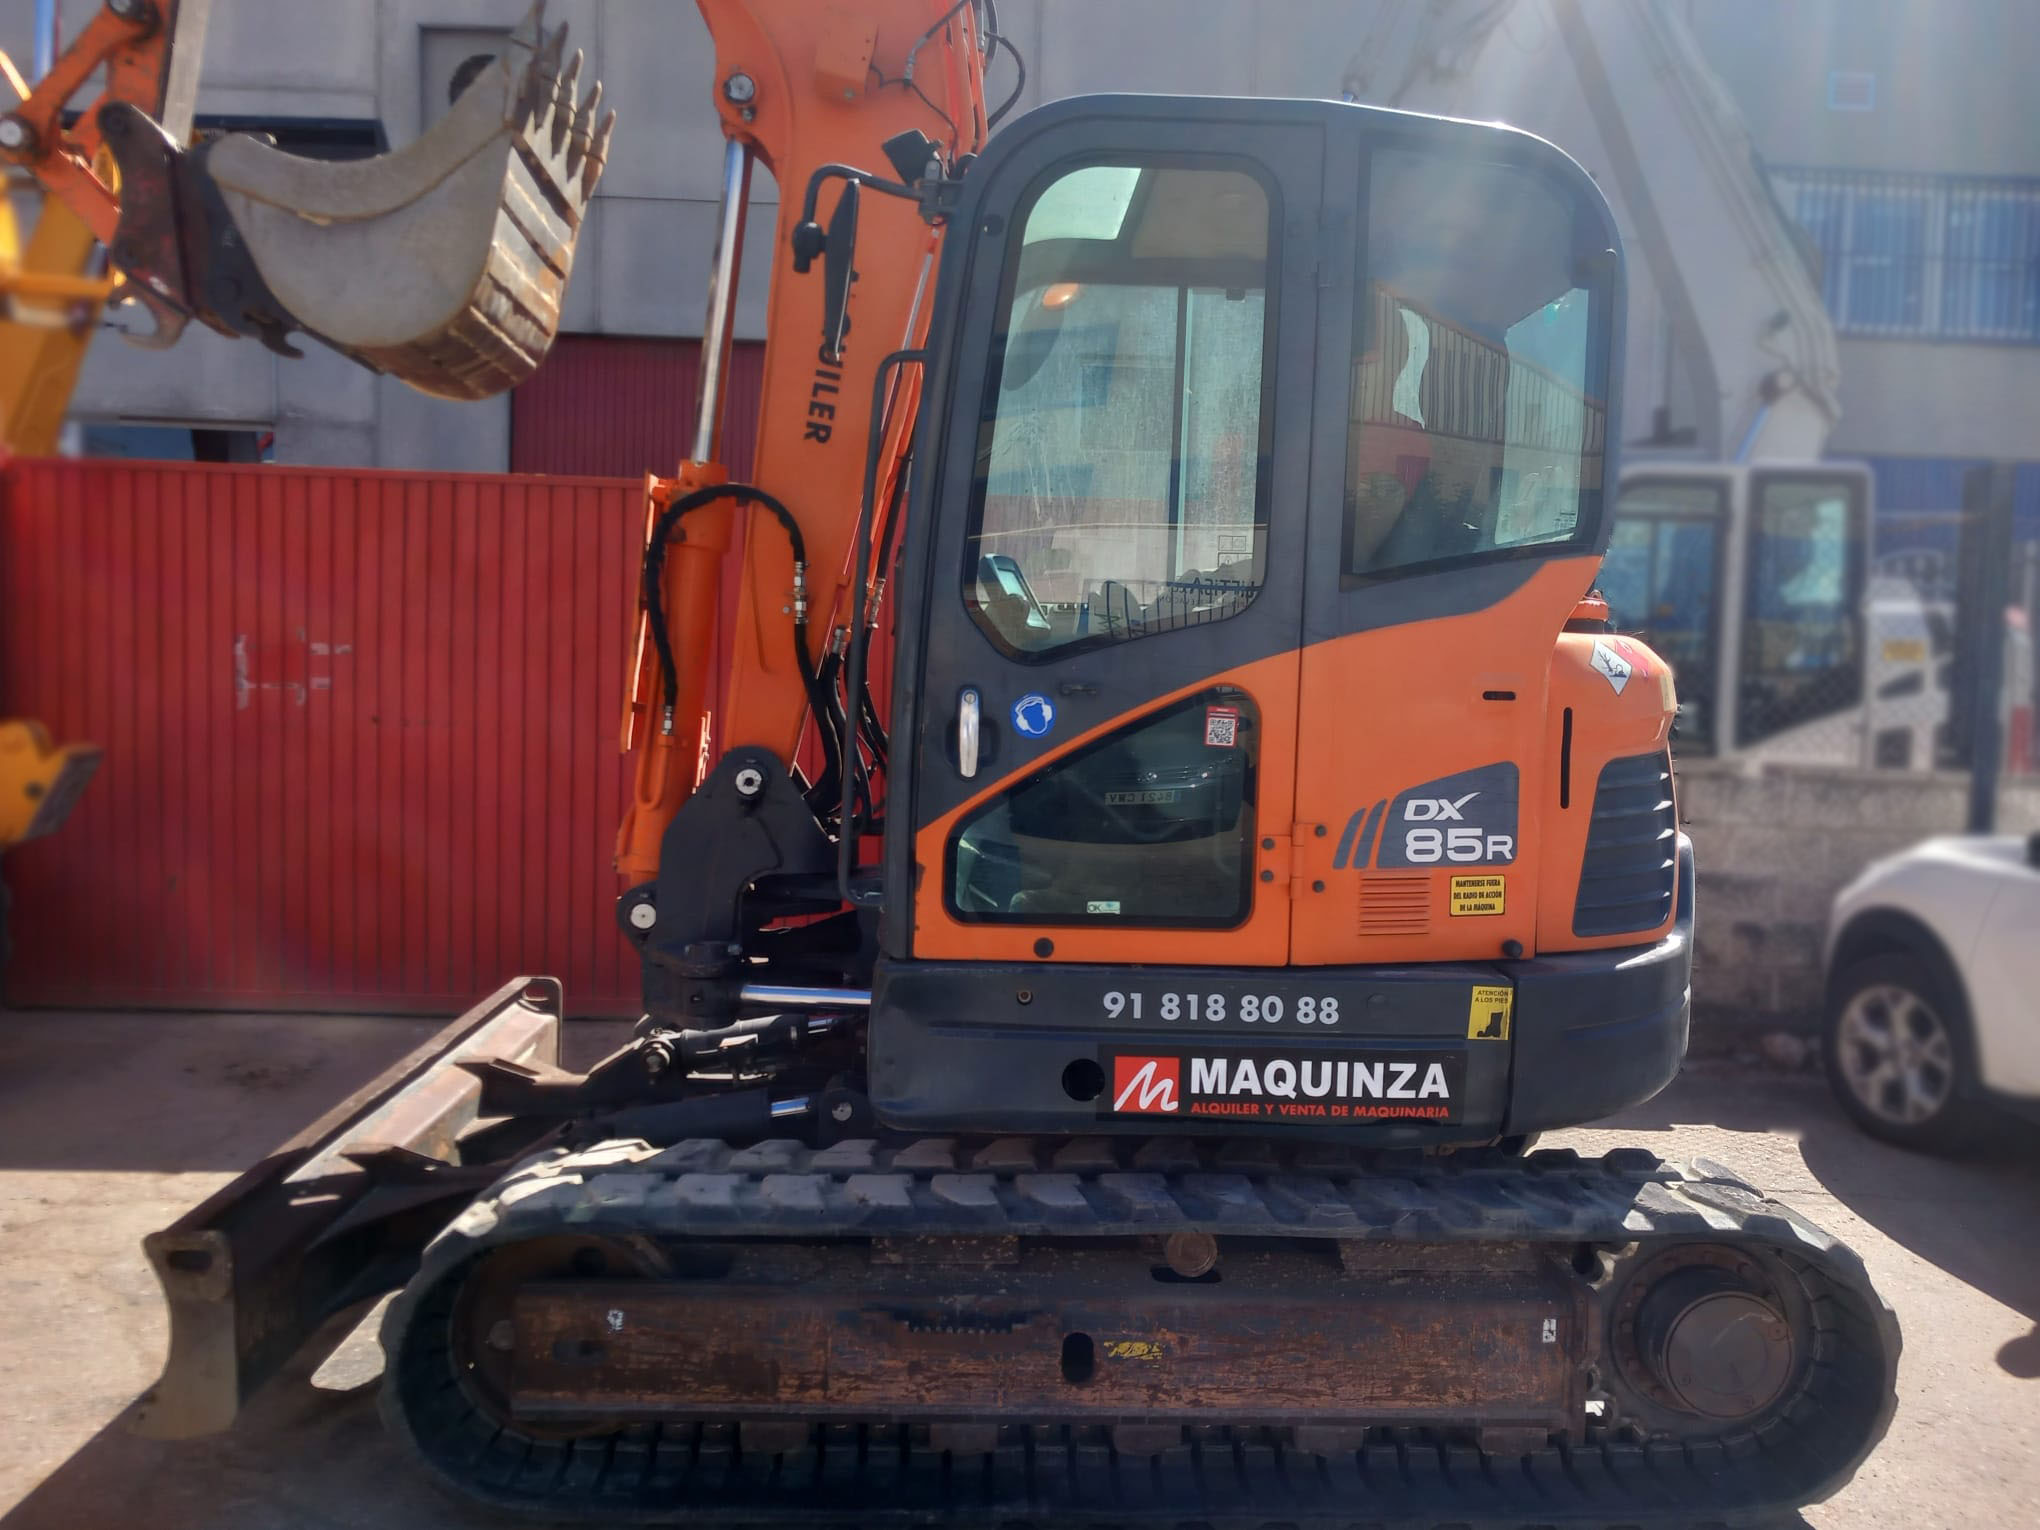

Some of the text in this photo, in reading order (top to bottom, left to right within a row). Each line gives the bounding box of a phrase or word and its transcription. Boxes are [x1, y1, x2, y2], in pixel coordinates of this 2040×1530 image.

[1404, 791, 1481, 821] DX
[1405, 828, 1513, 863] 85R
[1103, 991, 1339, 1025] 91 818 80 88
[1190, 1058, 1450, 1100] MAQUINZA
[1190, 1102, 1449, 1118] ALQUILER Y VENTA DE MAQUINARIA
